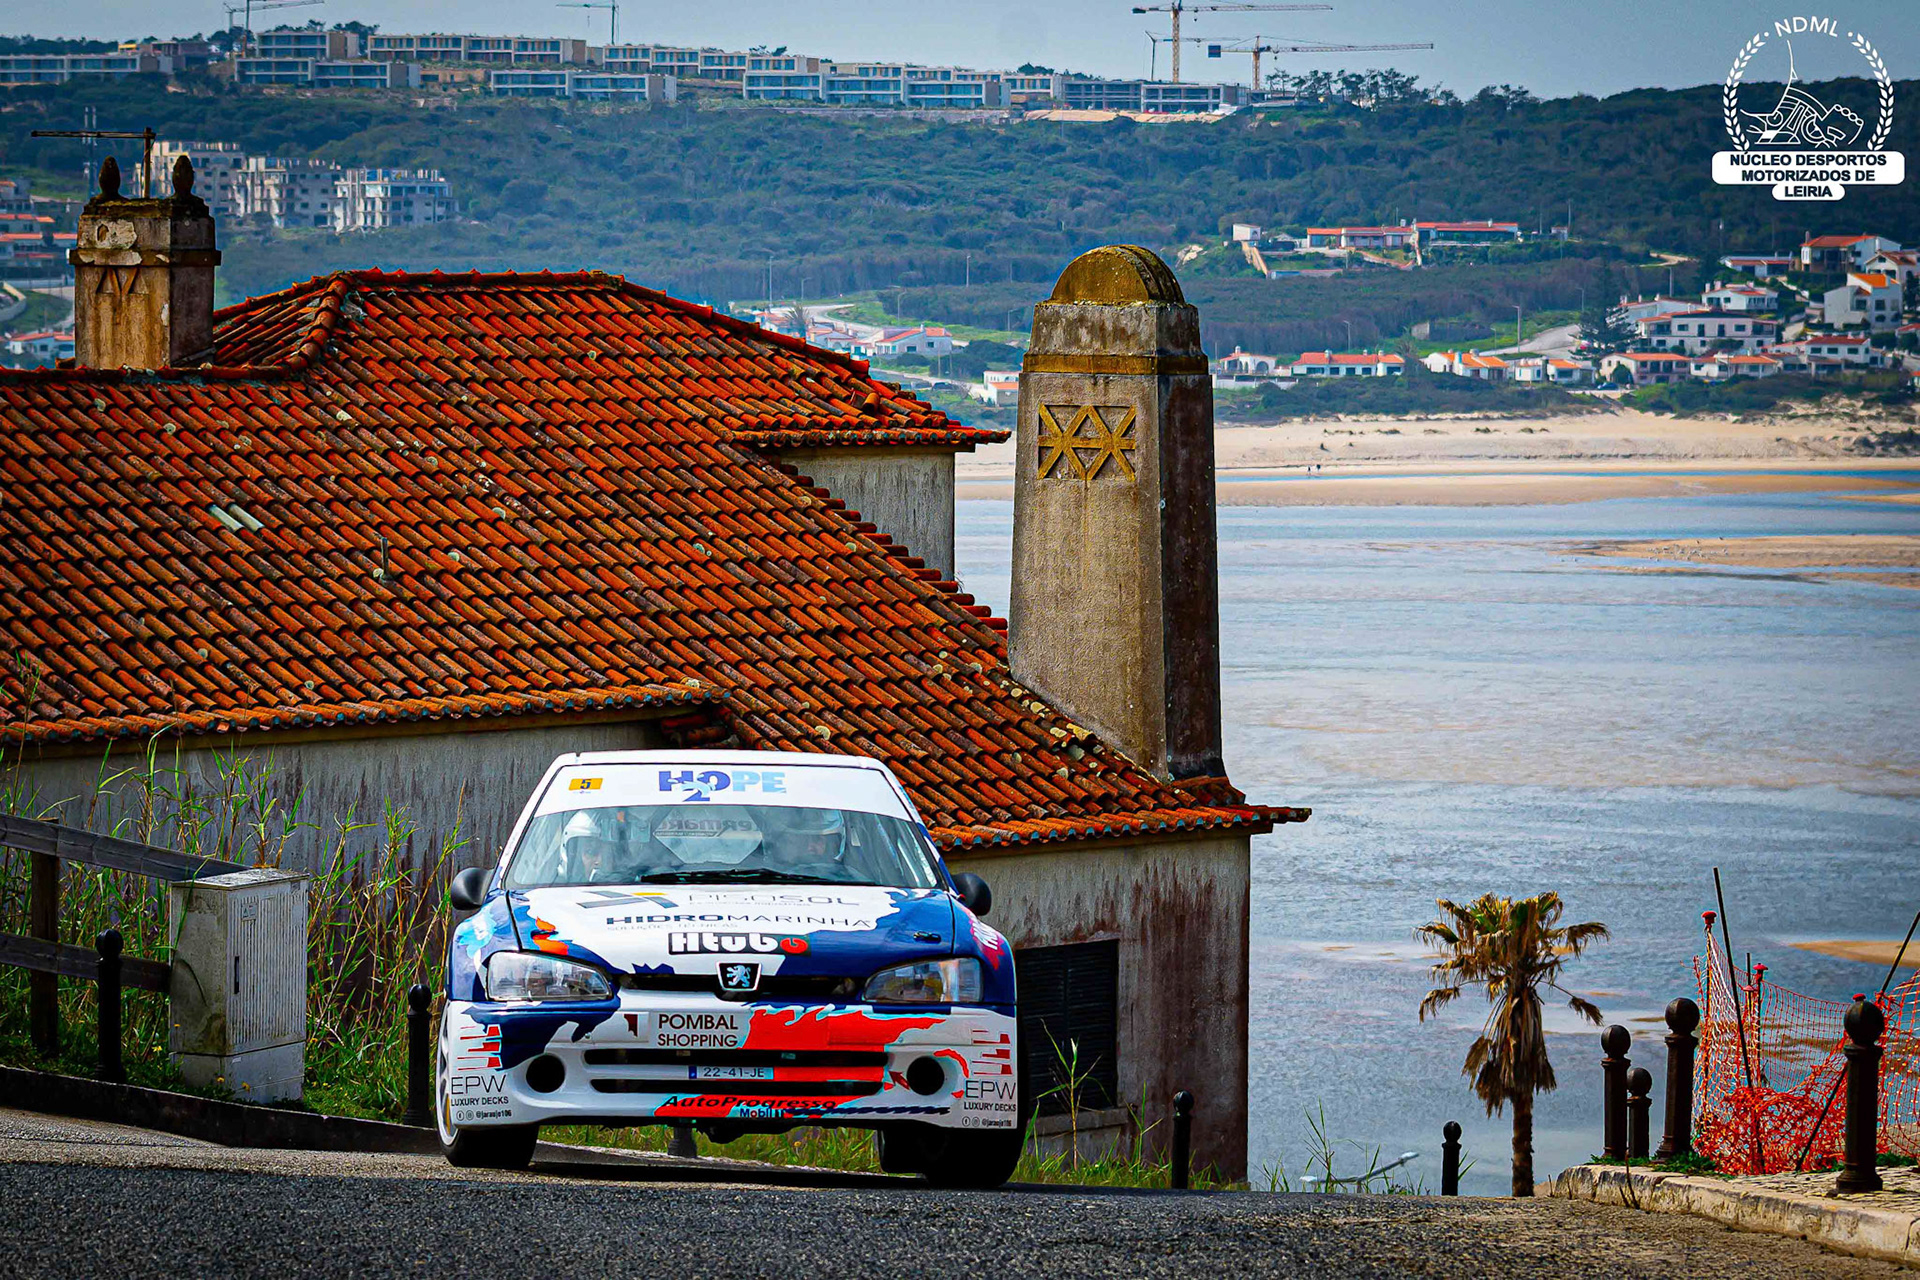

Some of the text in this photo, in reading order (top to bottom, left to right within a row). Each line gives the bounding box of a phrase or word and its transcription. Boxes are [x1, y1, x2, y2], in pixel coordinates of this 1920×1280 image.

[580, 779, 591, 790] 5
[606, 914, 871, 928] HIDROMARINHA
[658, 1013, 738, 1030] POMBAL
[657, 1033, 738, 1047] SHOPPING
[703, 1067, 765, 1078] 22-41-JE
[451, 1074, 507, 1095] EPW
[965, 1080, 1016, 1100] EPW
[450, 1096, 509, 1107] LUXURY DECKS
[662, 1095, 837, 1110] AutoProgresso
[963, 1101, 1017, 1112] LUXURY DECKS
